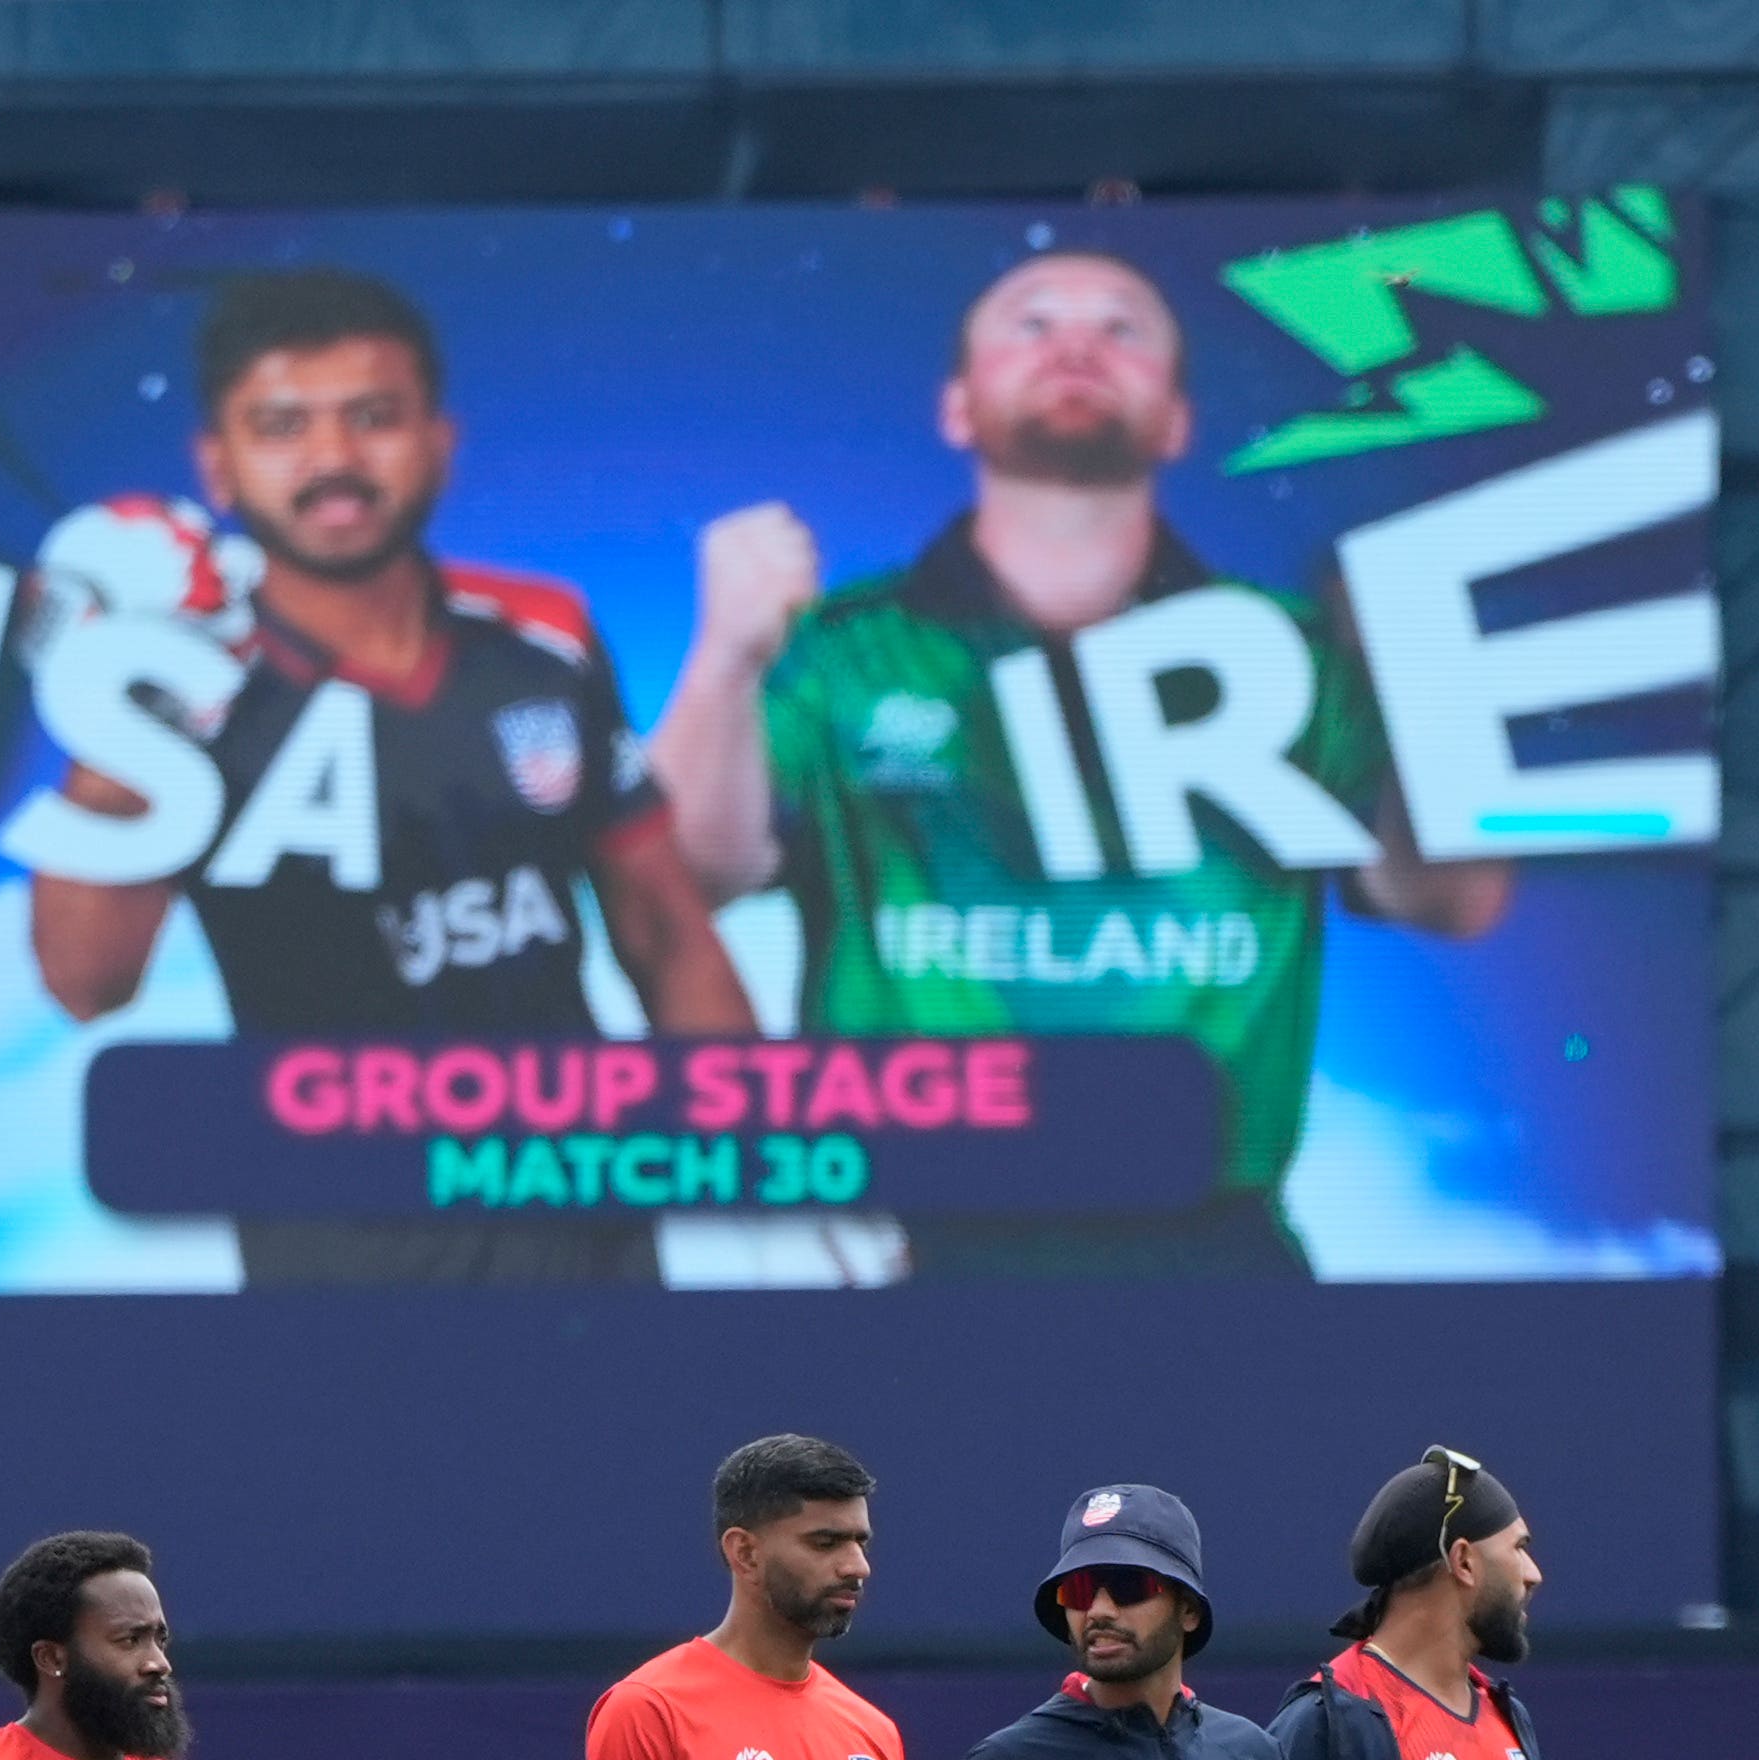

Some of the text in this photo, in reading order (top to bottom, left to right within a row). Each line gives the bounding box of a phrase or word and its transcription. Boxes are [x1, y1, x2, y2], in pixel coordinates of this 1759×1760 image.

[990, 406, 1722, 882] IRE
[872, 900, 1259, 988] IRELAND
[266, 1042, 1032, 1136] GROUP STAGE
[428, 1132, 870, 1208] MATCH 30
